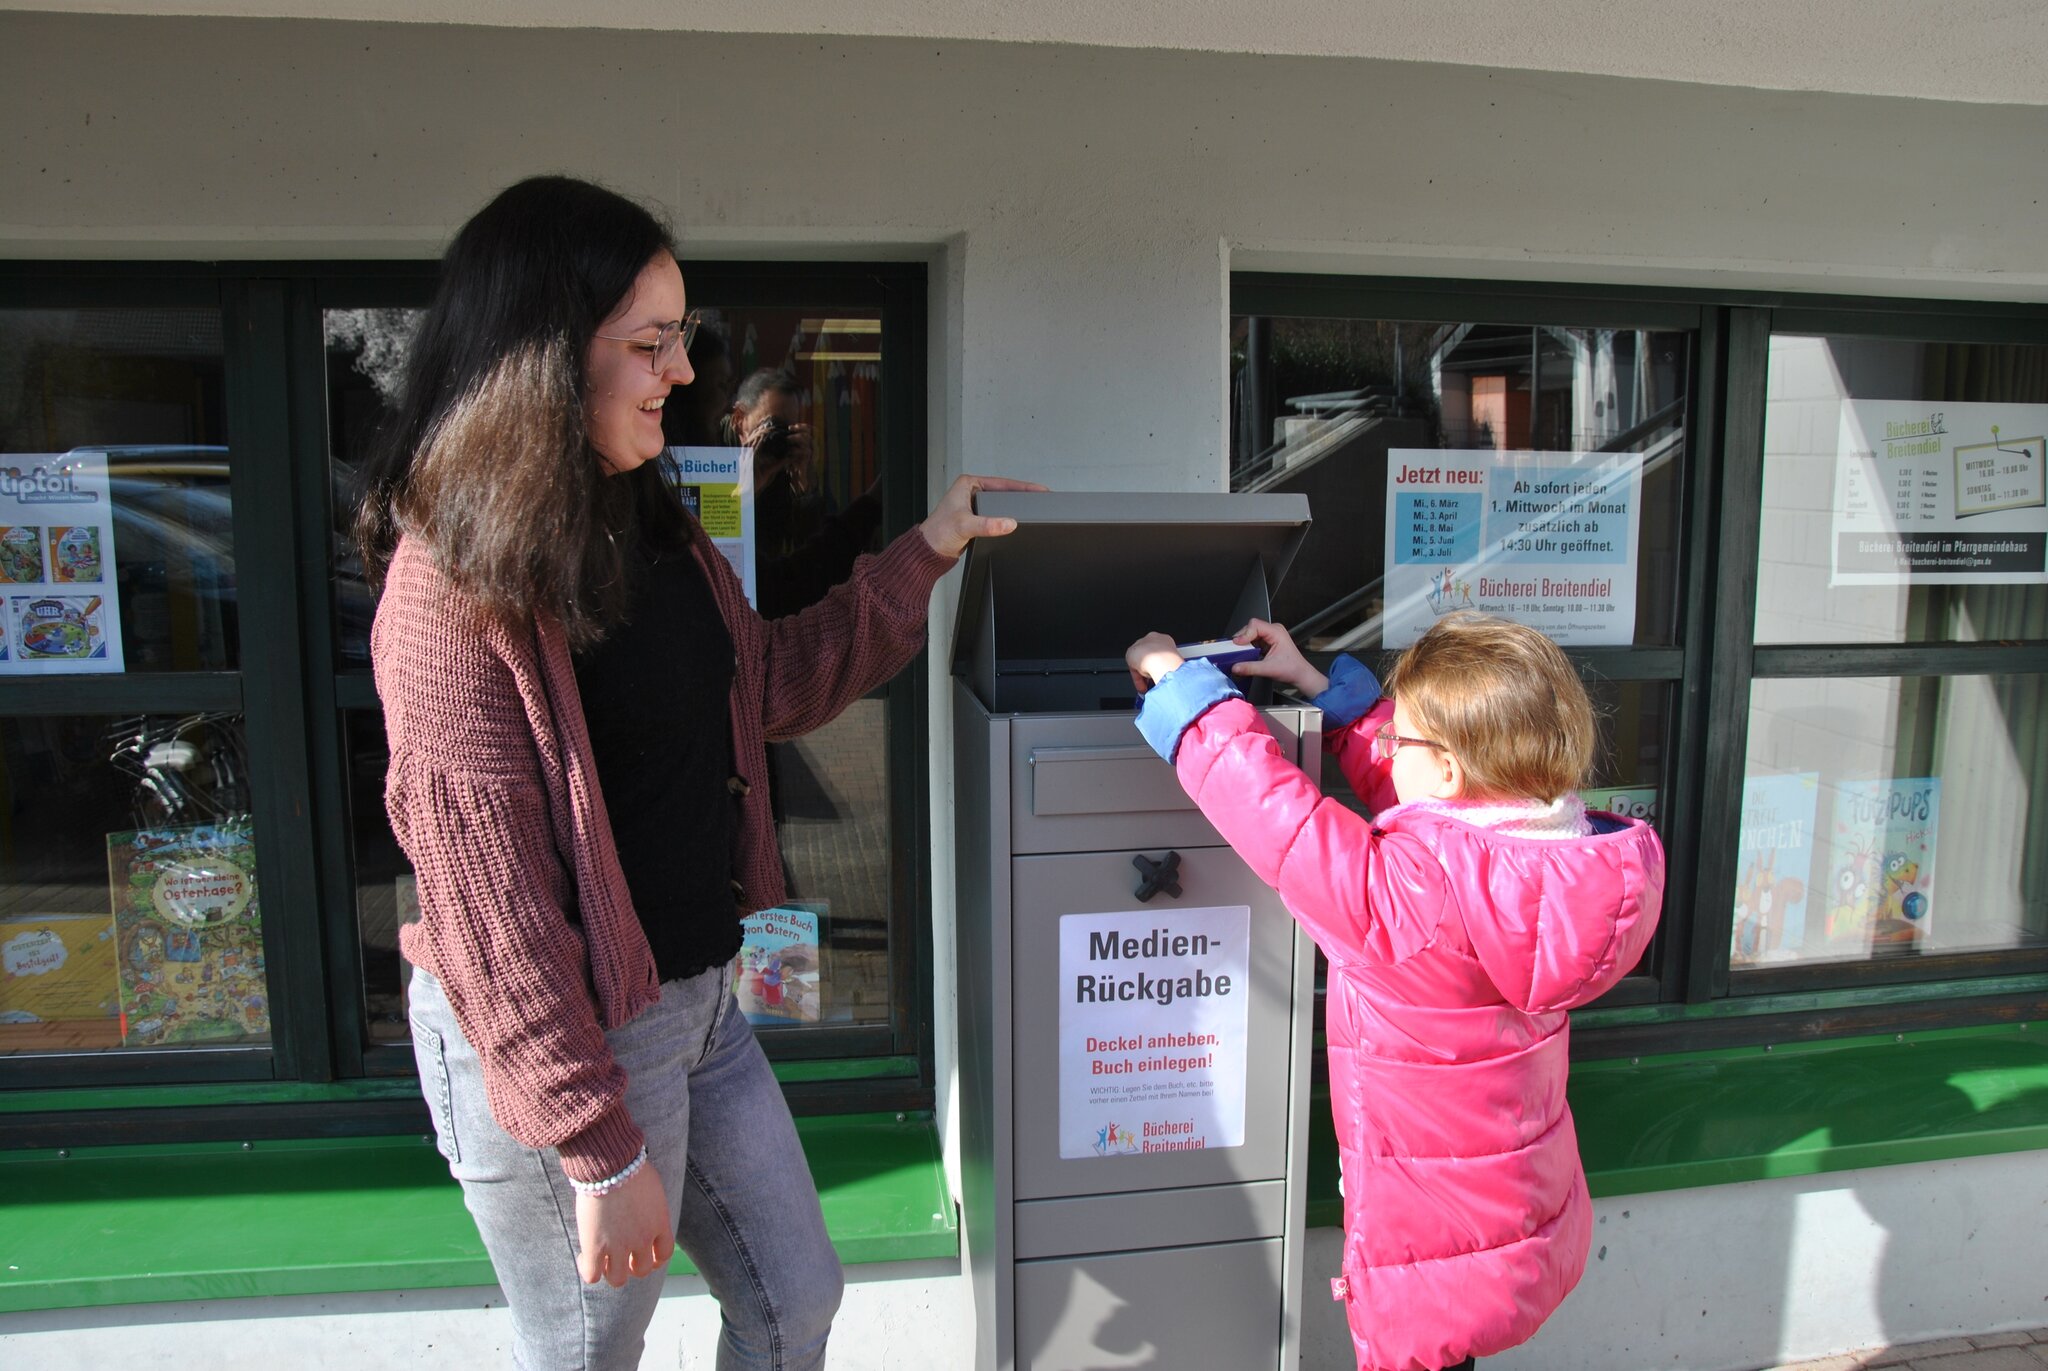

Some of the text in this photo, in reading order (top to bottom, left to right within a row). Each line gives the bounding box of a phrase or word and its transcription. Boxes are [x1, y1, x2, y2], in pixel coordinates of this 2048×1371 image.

[1886, 416, 1930, 437] Bücherei
[1887, 437, 1942, 459] Breitendiel
[671, 460, 737, 474] eBücher!
[1396, 465, 1484, 484] Jetzt neu:
[0, 466, 73, 500] tiptoi
[1514, 480, 1607, 496] Ab sofort jeden
[1439, 499, 1459, 508] März
[1492, 500, 1626, 514] 1. Mittwoch im Monat
[1430, 511, 1437, 520] 3.
[1438, 511, 1458, 522] April
[1438, 523, 1454, 532] Mai
[1518, 520, 1599, 533] zusätzlich ab
[1437, 536, 1455, 545] Juni
[1500, 539, 1614, 554] 14:30 Uhr geöffnet.
[1859, 540, 2028, 555] Bücherei Breitendiel im Pfarrgemeindehaus
[1437, 548, 1452, 557] Juli
[1479, 577, 1611, 598] Bücherei Breitendiel
[164, 877, 179, 887] Wo
[163, 882, 243, 901] Osterhase?
[760, 911, 788, 924] erstes
[790, 914, 813, 933] Buch
[765, 923, 801, 941] Ostern
[1089, 929, 1221, 961] Medien-
[1077, 969, 1232, 1006] Rückgabe
[1086, 1032, 1220, 1053] Deckel anheben,
[1092, 1053, 1213, 1075] Buch einlegen!
[1122, 1085, 1141, 1094] Legen
[1142, 1083, 1153, 1092] Sie
[1153, 1082, 1167, 1091] dem
[1199, 1080, 1214, 1088] bitte
[1089, 1096, 1109, 1105] vorher
[1110, 1096, 1128, 1104] einen
[1129, 1093, 1147, 1103] Zettel
[1148, 1093, 1159, 1101] mit
[1160, 1091, 1177, 1100] Ihrem
[1178, 1090, 1200, 1099] Namen
[1143, 1117, 1193, 1137] Bücherei
[1143, 1135, 1205, 1153] Breitendiel
